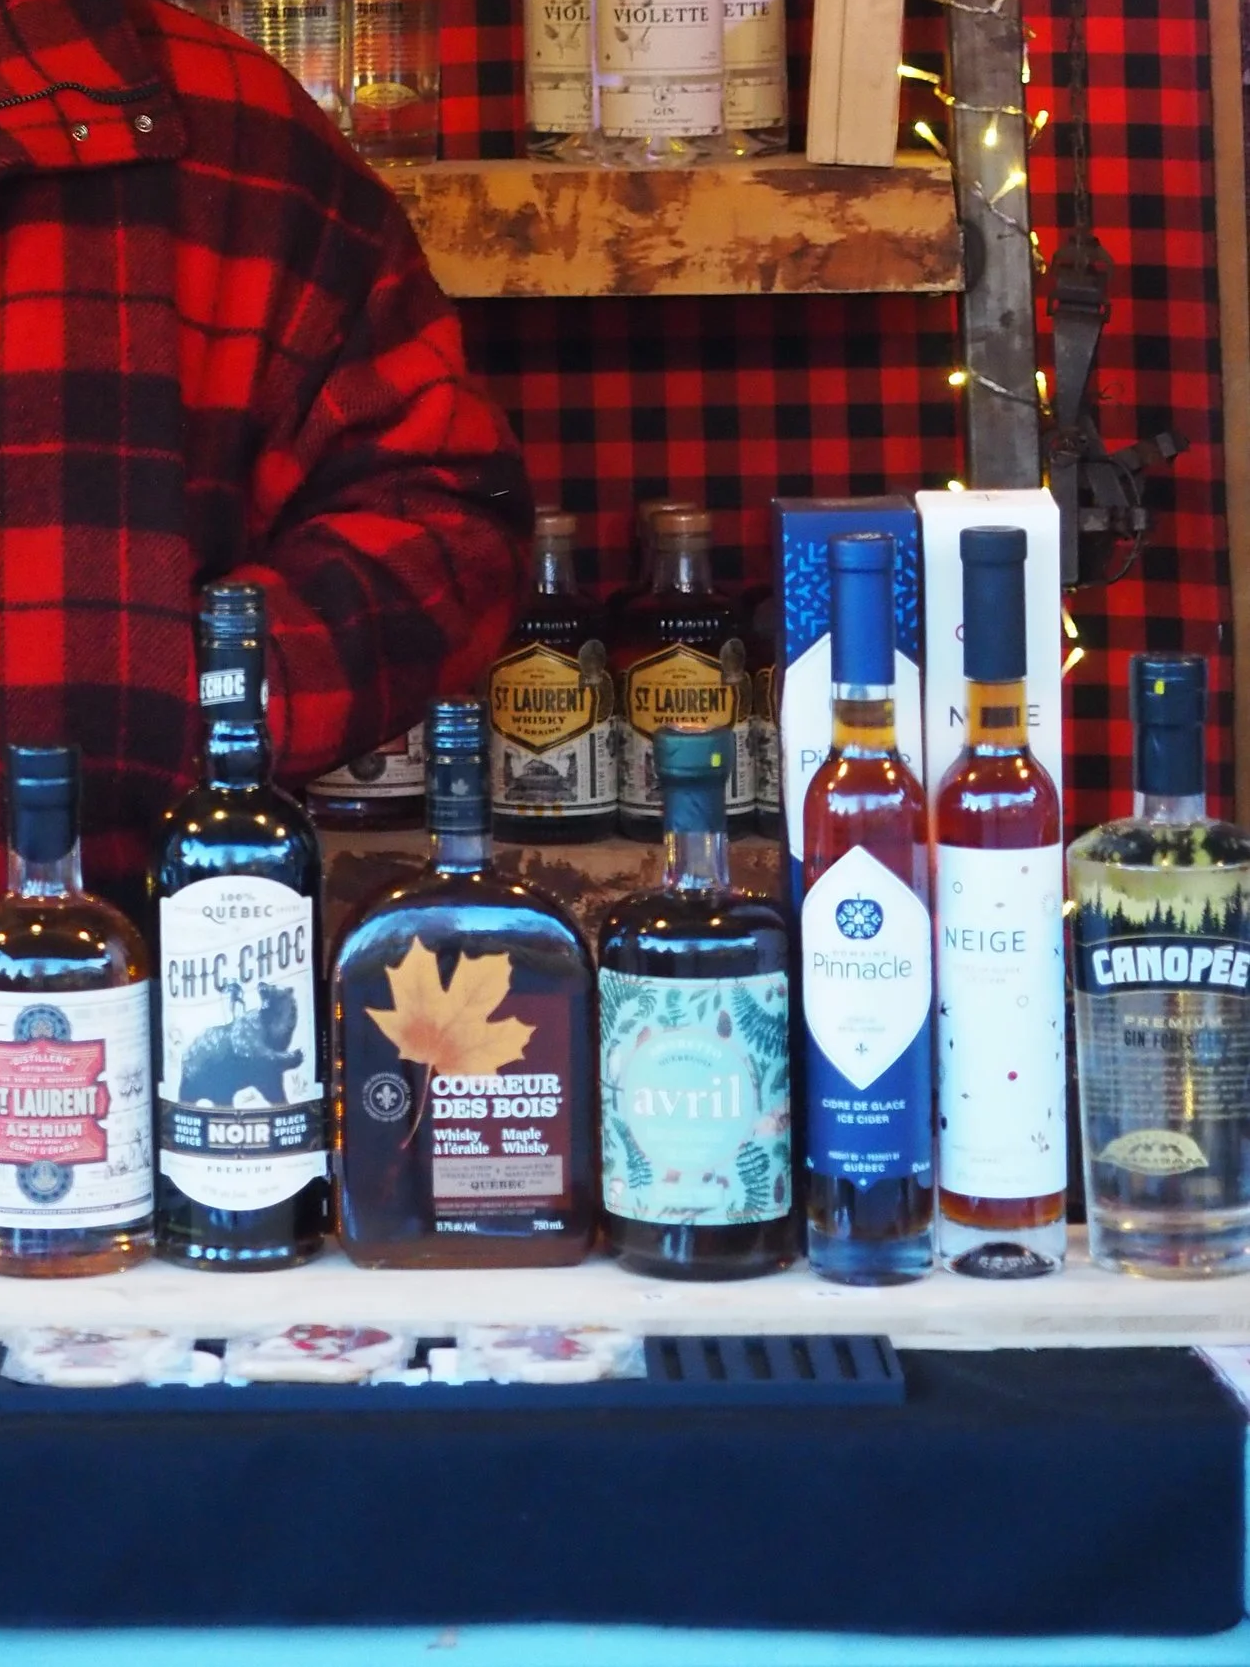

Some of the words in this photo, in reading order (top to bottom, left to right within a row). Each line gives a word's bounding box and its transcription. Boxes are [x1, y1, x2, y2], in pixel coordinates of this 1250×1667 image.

[613, 7, 710, 24] VIOLETTE
[653, 107, 676, 116] GIN
[513, 686, 587, 713] LAURENT
[654, 687, 729, 713] LAURENT
[511, 715, 567, 725] WHISKY
[201, 904, 274, 925] QUÉBEC
[944, 925, 1027, 953] NEIGE
[167, 952, 228, 999] CHIC
[238, 924, 306, 984] CHOC
[813, 951, 912, 980] Pinnacle
[1092, 945, 1250, 988] CANOPÉE
[1123, 1014, 1224, 1029] PREMIUM
[1123, 1030, 1146, 1047] GIN
[431, 1073, 561, 1097] COUREUR
[12, 1084, 99, 1118] LAURENT
[632, 1074, 743, 1120] avril
[822, 1098, 851, 1111] CIDRE
[852, 1101, 869, 1112] DE
[870, 1099, 906, 1112] GLACE
[432, 1098, 489, 1119] DES
[492, 1097, 559, 1119] BOIS
[274, 1113, 306, 1127] BLACK
[837, 1114, 855, 1124] ICE
[856, 1114, 890, 1125] CIDER
[5, 1122, 83, 1138] ACERUM
[208, 1123, 271, 1145] NOIR
[273, 1123, 307, 1137] SPICED
[433, 1128, 482, 1142] Whisky
[501, 1127, 543, 1142] Maple
[502, 1141, 549, 1157] Whisky
[206, 1165, 273, 1174] PREMIUM
[842, 1161, 886, 1173] QUÉBEC
[469, 1176, 527, 1191] QUÉBEC
